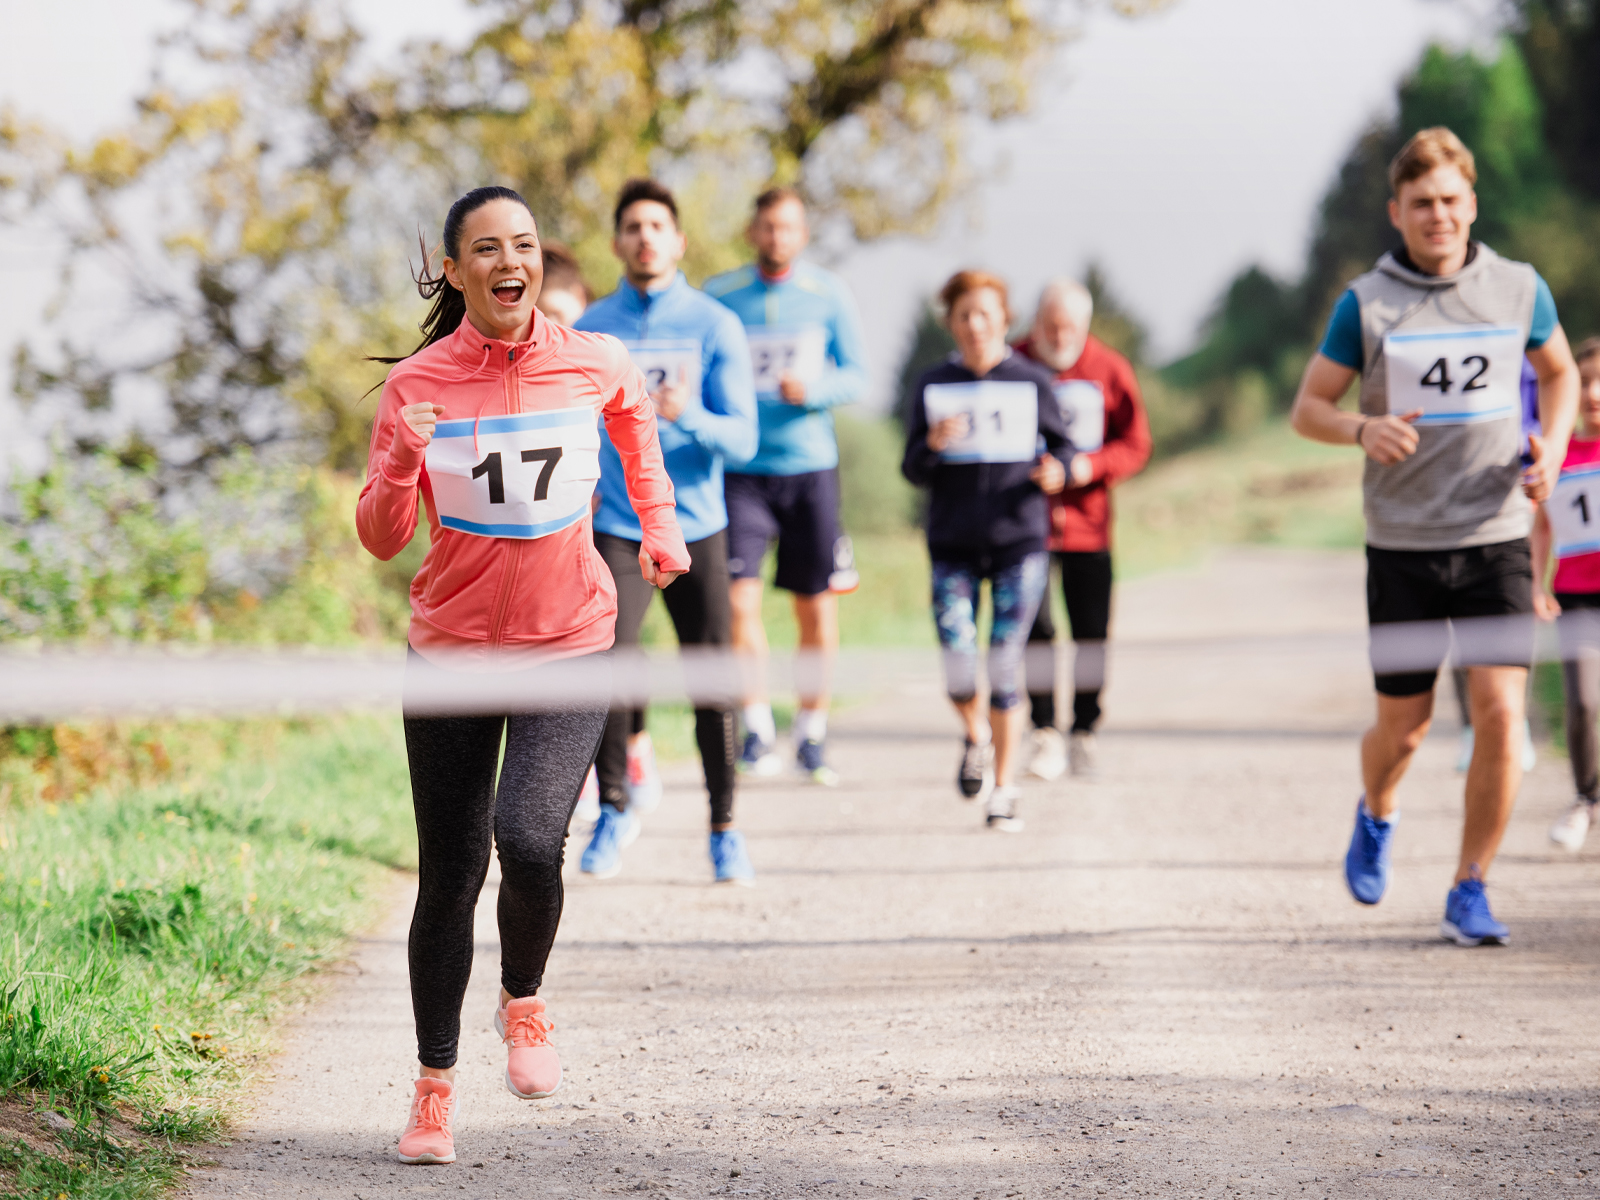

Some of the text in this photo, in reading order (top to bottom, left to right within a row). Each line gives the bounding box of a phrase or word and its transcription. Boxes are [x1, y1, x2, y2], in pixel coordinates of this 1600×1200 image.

[1420, 354, 1488, 393] 42
[471, 446, 563, 504] 17
[1571, 494, 1590, 523] 1
